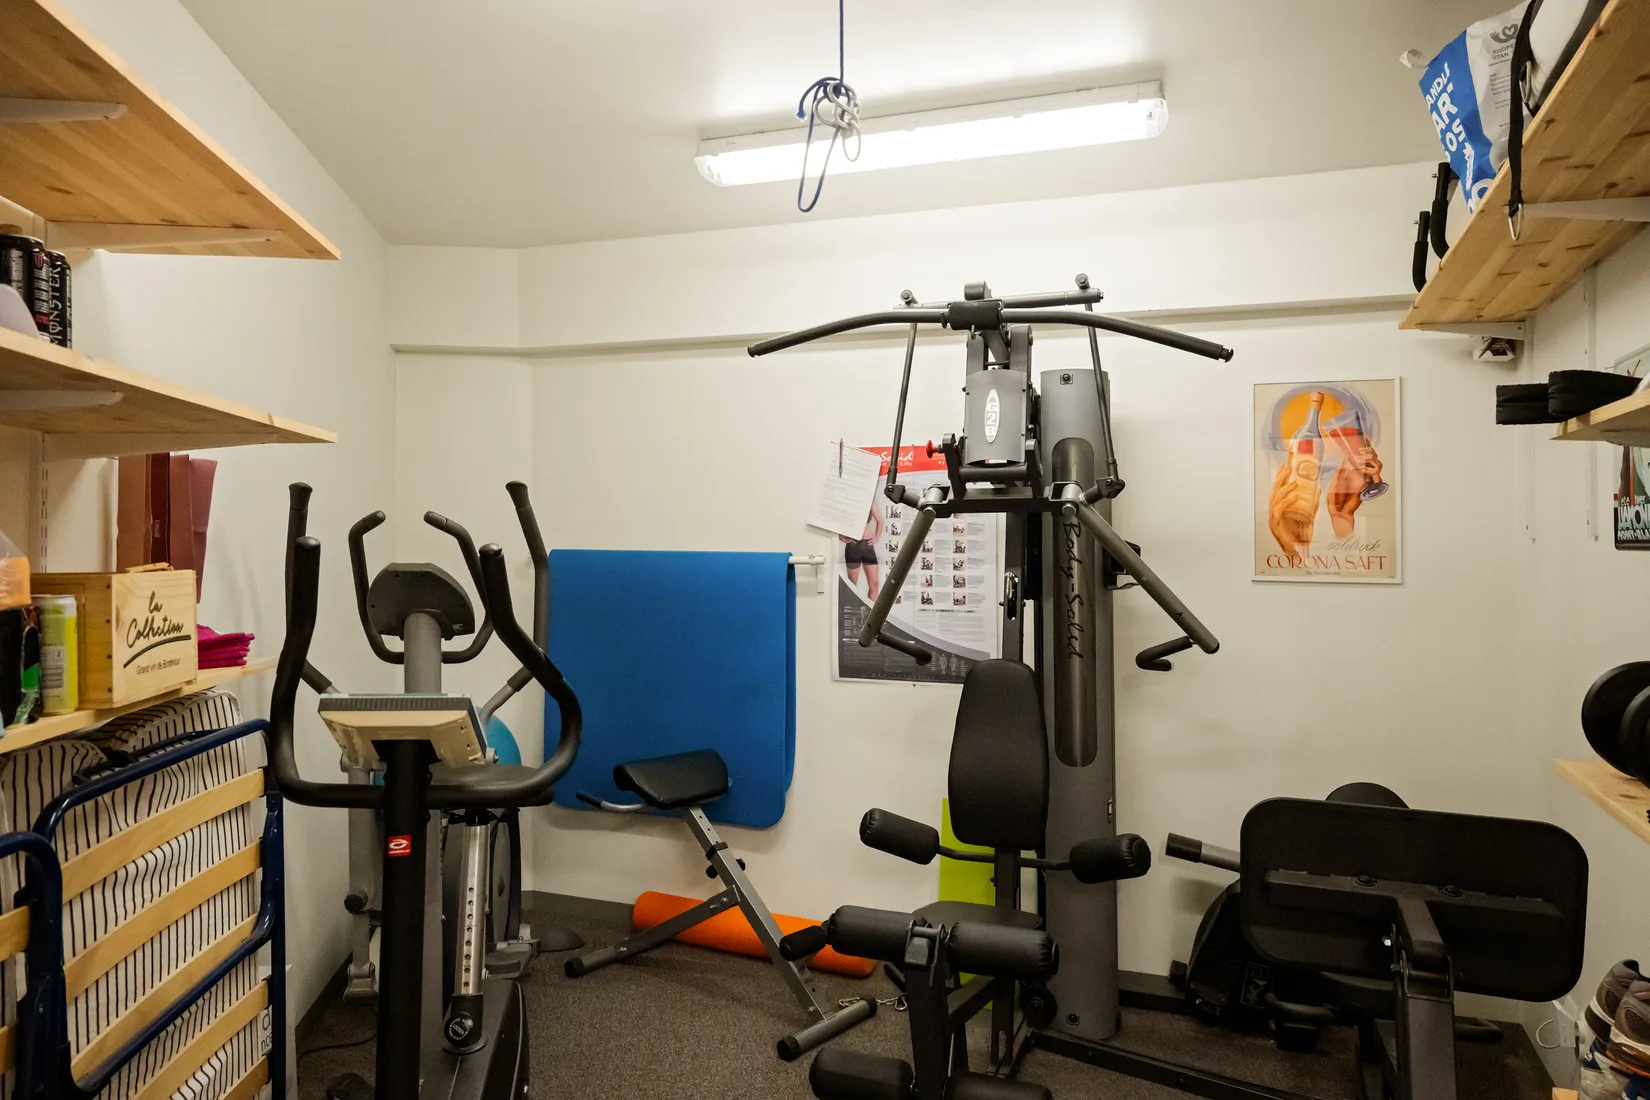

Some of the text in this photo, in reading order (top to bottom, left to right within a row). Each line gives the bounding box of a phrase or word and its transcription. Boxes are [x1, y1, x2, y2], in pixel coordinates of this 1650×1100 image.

[49, 266, 62, 344] MONSTER
[1061, 521, 1085, 660] Body-Solid
[1266, 554, 1387, 571] CORONA SAFT
